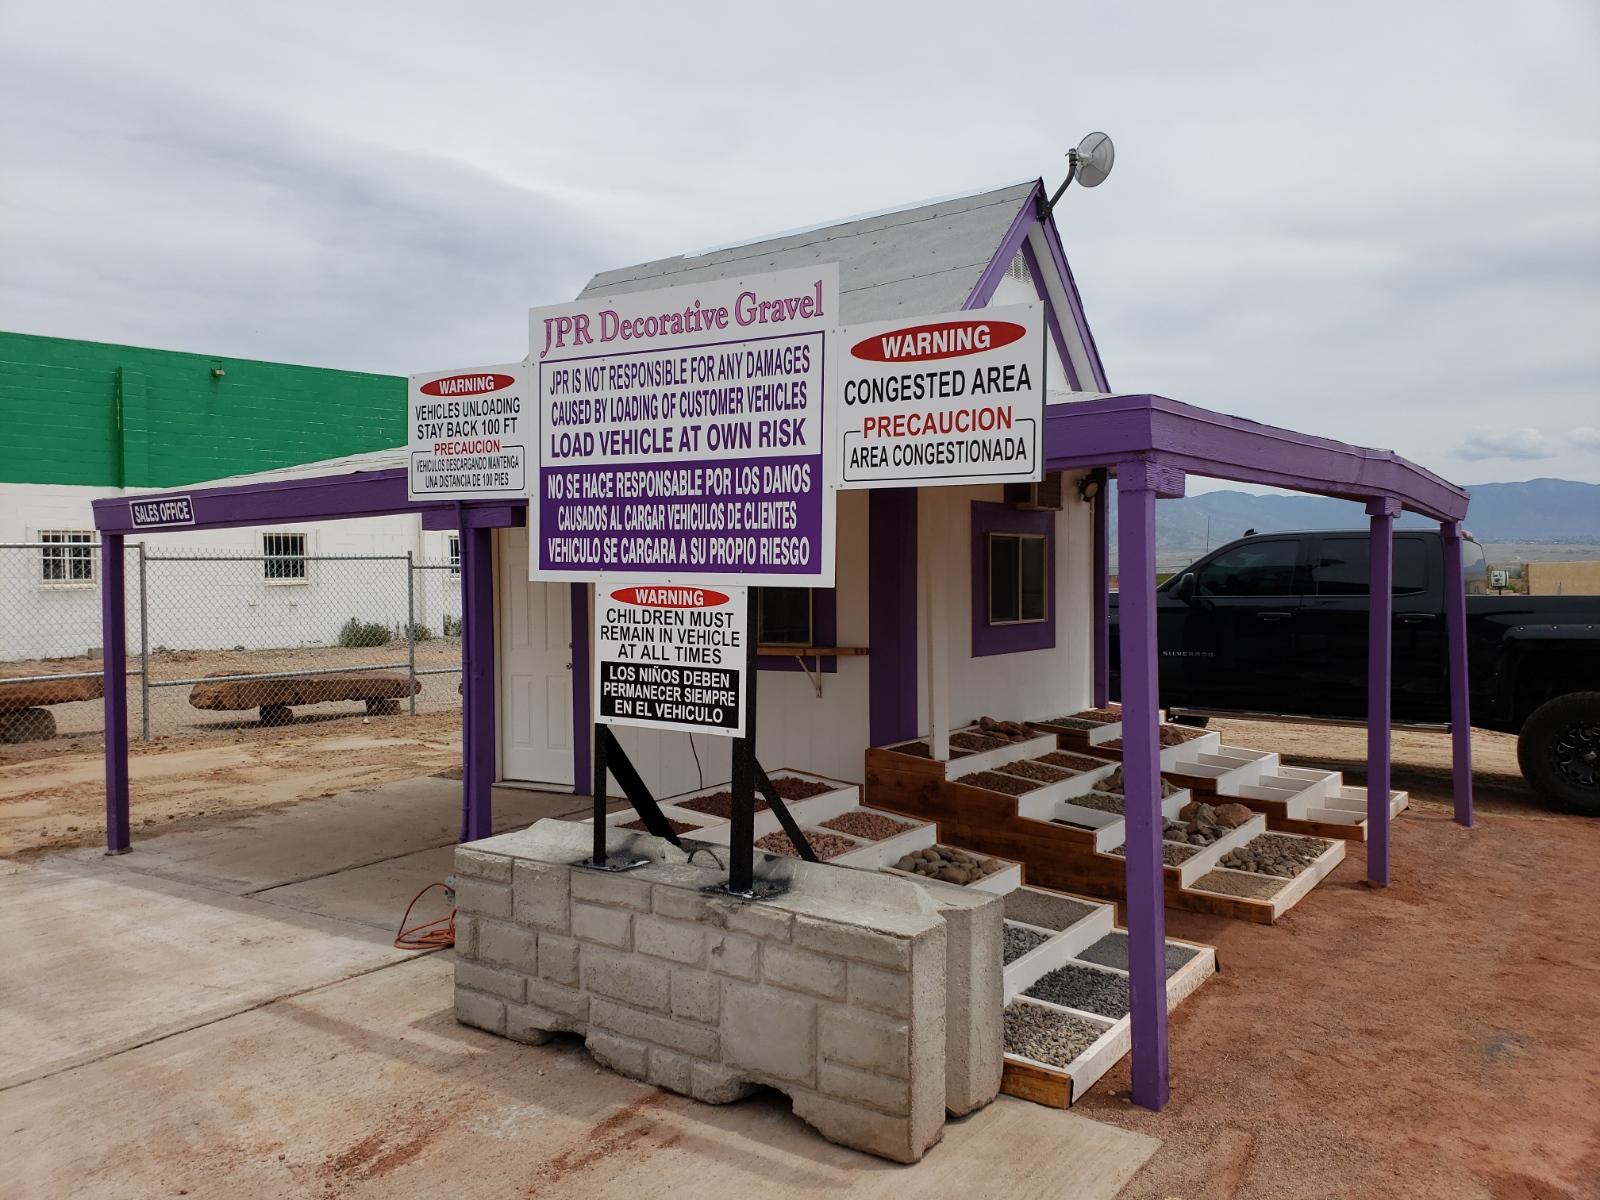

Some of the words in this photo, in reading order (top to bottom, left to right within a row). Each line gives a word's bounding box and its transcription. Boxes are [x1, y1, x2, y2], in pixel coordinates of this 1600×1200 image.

[540, 313, 593, 357] JPR
[599, 299, 728, 342] Decorative
[735, 280, 824, 327] Gravel
[882, 325, 990, 359] WARNING
[550, 370, 569, 395] JPR
[572, 368, 581, 393] IS
[584, 366, 605, 392] NOT
[609, 358, 687, 390] RESPONSIBLE
[691, 354, 714, 383] FOR
[717, 352, 743, 381] ANY
[746, 345, 810, 378] DAMAGES
[439, 376, 494, 394] WARNING
[844, 370, 965, 406] CONGESTED
[971, 364, 1032, 395] AREA
[416, 402, 460, 421] VEHICLES
[463, 397, 520, 417] UNLOADING
[551, 400, 591, 426] CAUSED
[595, 399, 606, 423] BY
[611, 394, 657, 421] LOADING
[662, 393, 676, 419] OF
[680, 387, 744, 418] CUSTOMER
[747, 381, 807, 413] VEHICLES
[418, 423, 443, 439] STAY
[447, 420, 478, 437] BACK
[482, 419, 499, 435] 100
[504, 417, 517, 433] FT
[863, 406, 1011, 438] PRECAUCION
[435, 440, 500, 455] PRECAUCION
[551, 432, 594, 458] LOAD
[600, 428, 673, 456] VEHICLE
[679, 426, 701, 452] AT
[707, 422, 751, 450] OWN
[759, 418, 806, 448] RISK
[416, 459, 445, 472] VEHICULOS
[447, 457, 486, 472] DESCARGANDO
[488, 456, 519, 469] MANTENGA
[850, 446, 888, 468] AREA
[893, 437, 1027, 466] CONGESTIONADA
[426, 475, 438, 488] UNA
[440, 474, 471, 488] DISTANCIA
[473, 474, 481, 486] DE
[483, 473, 492, 486] 100
[494, 473, 508, 485] PIES
[548, 473, 563, 499] NO
[566, 473, 579, 498] SE
[583, 471, 613, 498] HACE
[617, 468, 702, 498] RESPONSABLE
[706, 467, 731, 495] POR
[735, 466, 759, 494] LOS
[764, 464, 811, 493] DANOS
[135, 504, 159, 523] SALES
[160, 501, 189, 521] OFFICE
[558, 504, 607, 531] CAUSADOS
[610, 505, 622, 530] AL
[624, 503, 665, 530] CARGAR
[668, 502, 724, 530] VEHICULOS
[728, 502, 741, 529] DE
[744, 501, 797, 530] CLIENTES
[548, 538, 600, 563] VEHICULO
[604, 538, 617, 563] SE
[621, 537, 676, 564] CARGARA
[679, 538, 687, 564] A
[690, 537, 706, 564] SU
[710, 537, 756, 565] PROPIO
[760, 536, 809, 565] RIESGO
[635, 589, 703, 606] WARNING
[606, 608, 684, 626] CHILDREN
[690, 611, 734, 628] MUST
[601, 626, 654, 642] REMAIN
[660, 628, 672, 643] IN
[678, 629, 739, 647] VEHICLE
[618, 644, 636, 658] AT
[641, 645, 669, 661] ALL
[675, 646, 721, 664] TIMES
[610, 666, 635, 680] LOS
[639, 666, 679, 684] NIÑOS
[684, 671, 730, 688] DEBEN
[604, 682, 681, 701] PERMANECER
[684, 688, 735, 706] SIEMPRE
[615, 700, 632, 714] EN
[636, 701, 652, 716] EL
[655, 703, 723, 723] VEHICULO
